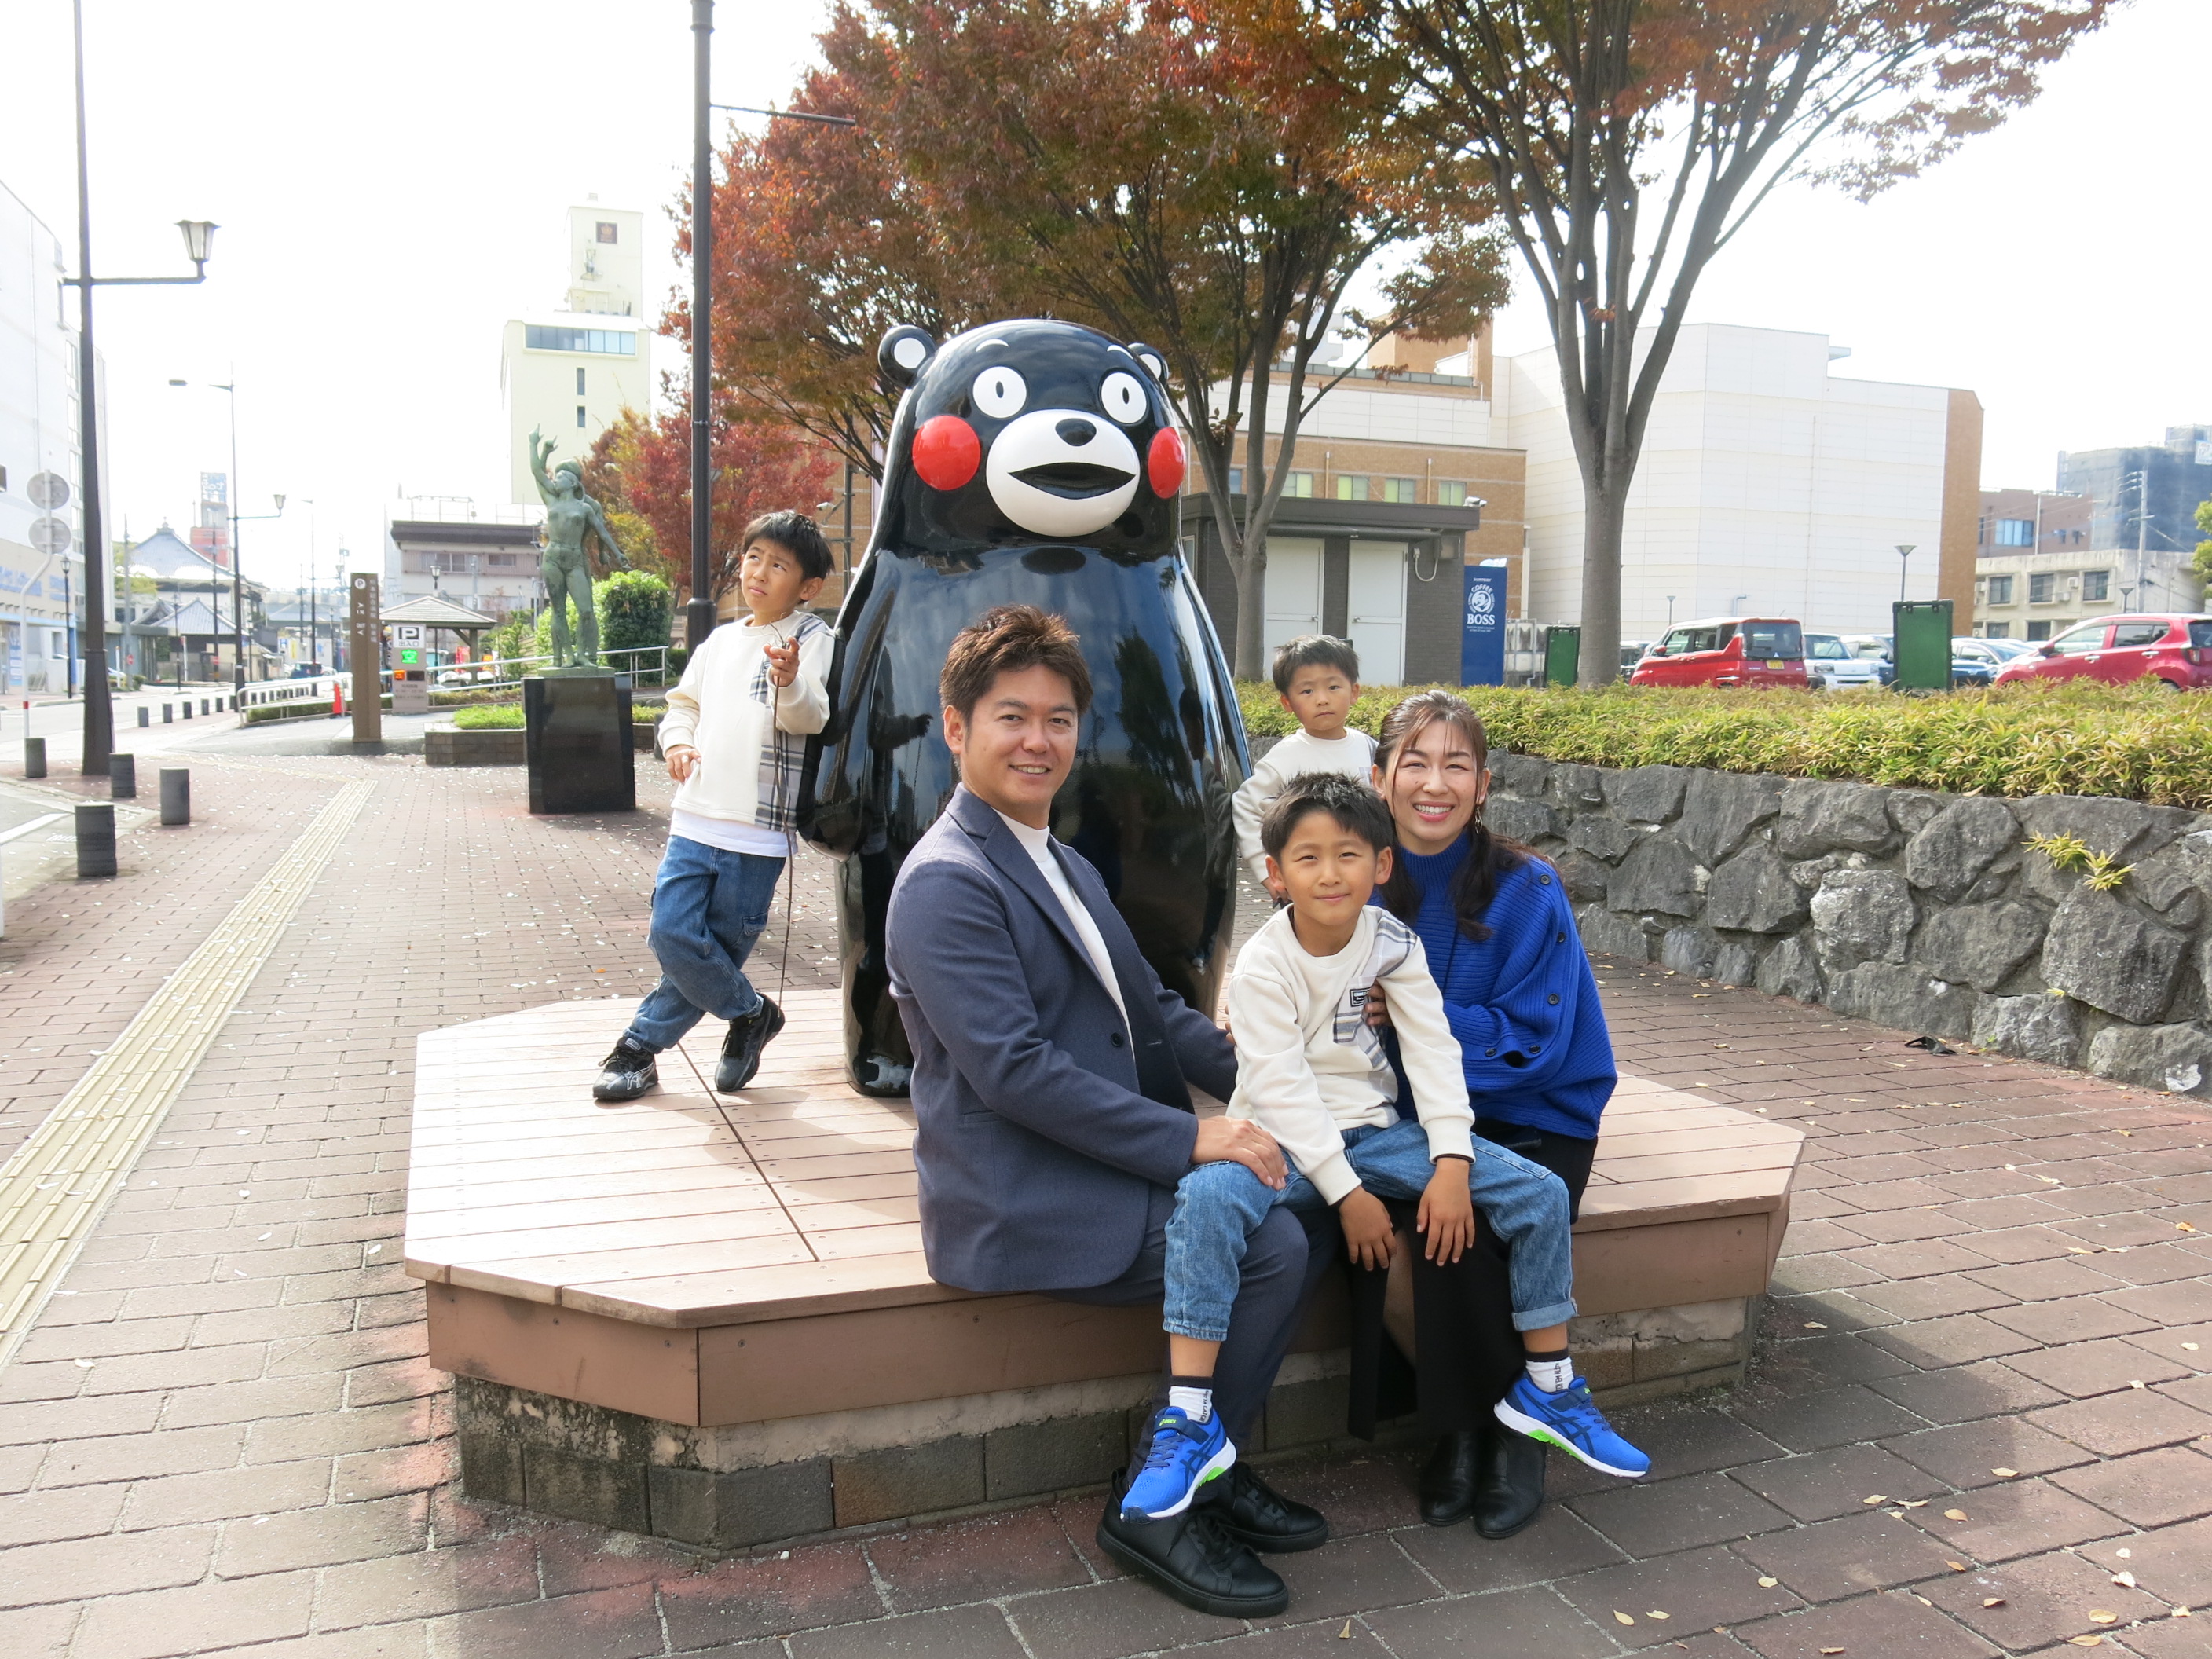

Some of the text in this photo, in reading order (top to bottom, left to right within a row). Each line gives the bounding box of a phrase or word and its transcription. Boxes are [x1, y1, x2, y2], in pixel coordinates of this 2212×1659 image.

[1471, 584, 1493, 594] COFFEE
[1467, 613, 1496, 625] BOSS
[401, 627, 417, 639] P
